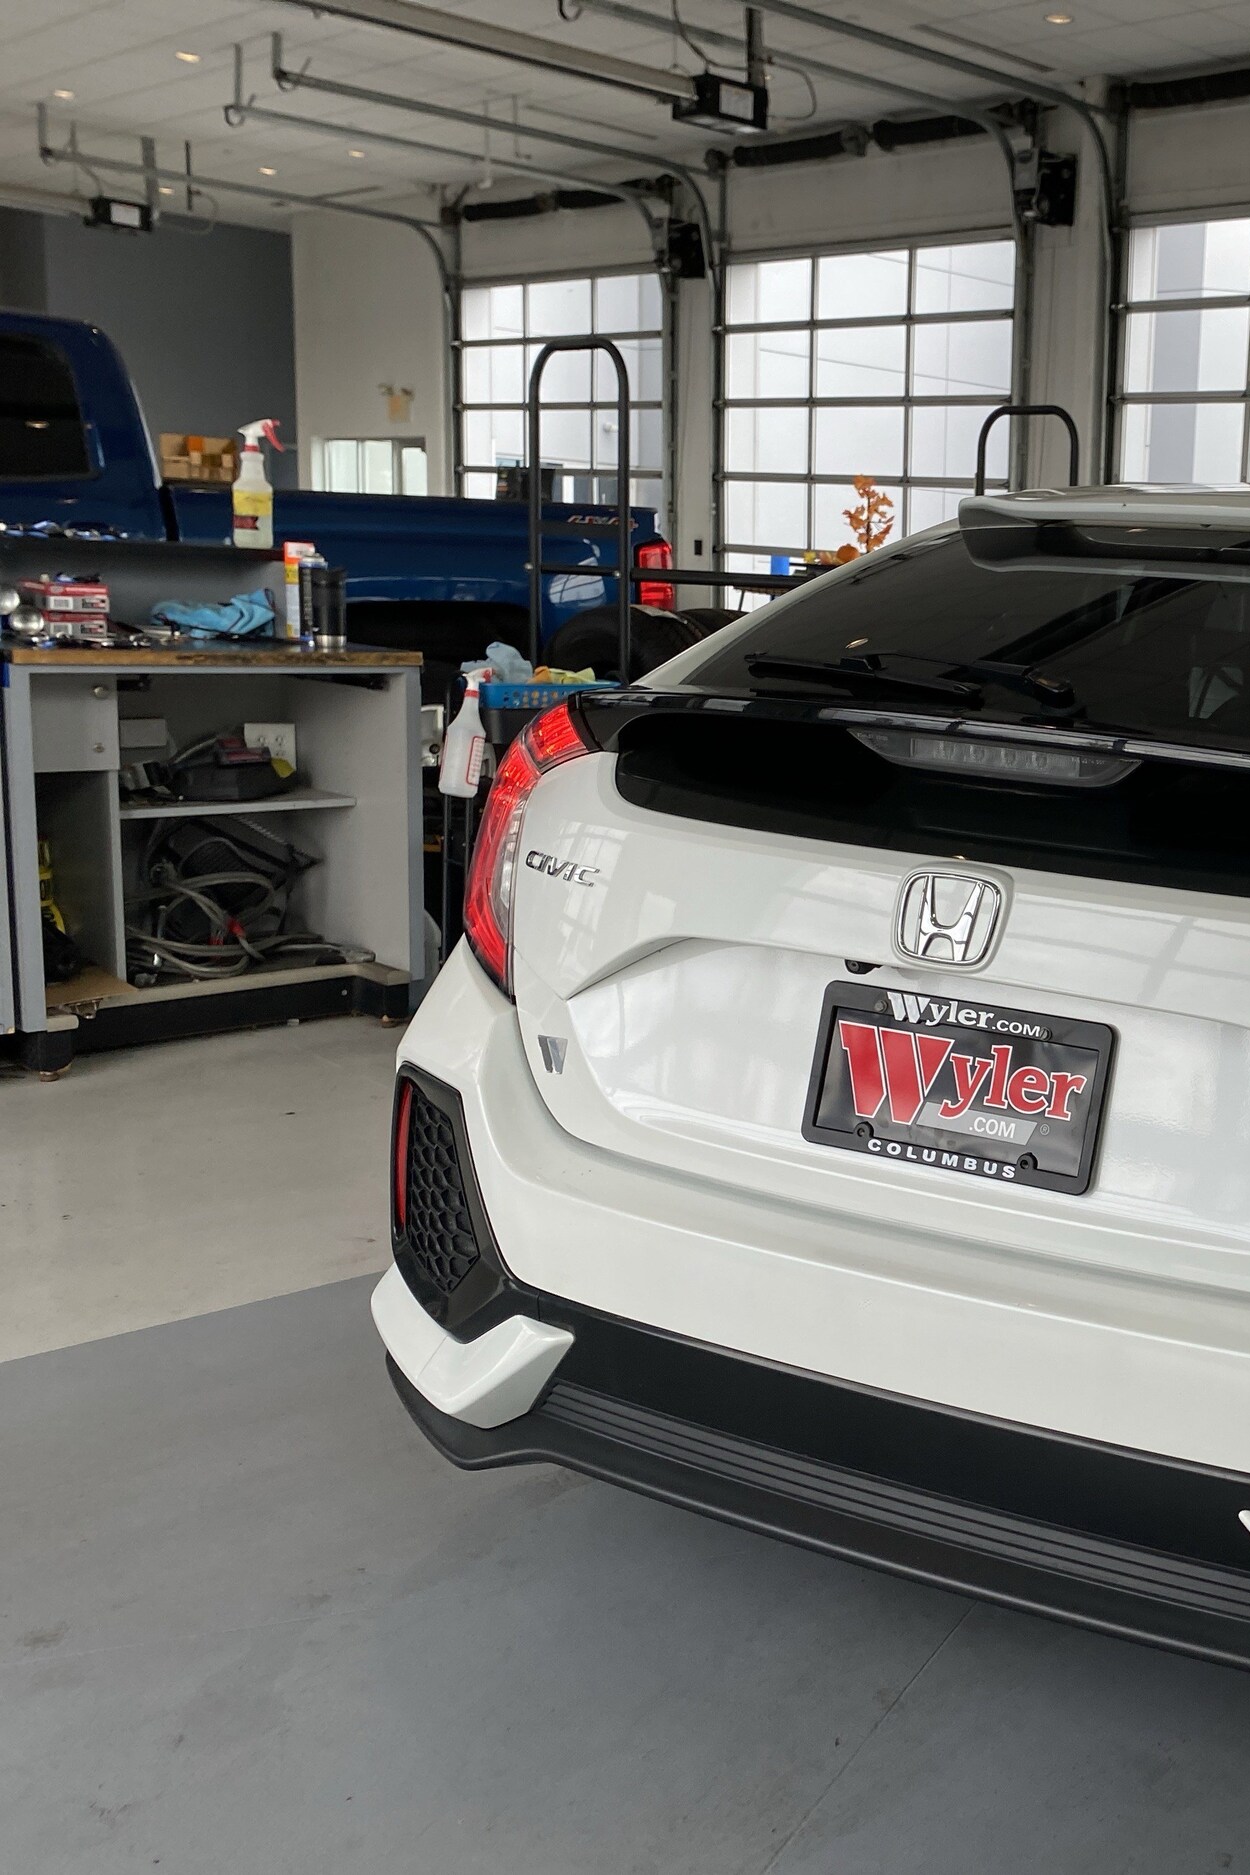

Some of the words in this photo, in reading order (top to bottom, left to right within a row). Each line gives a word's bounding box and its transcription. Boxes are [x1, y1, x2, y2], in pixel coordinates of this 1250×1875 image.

[525, 850, 601, 888] CIVIC
[838, 1019, 1088, 1126] Wyler
[968, 1116, 1017, 1139] .COM
[867, 1138, 1016, 1179] COLUMBUS
